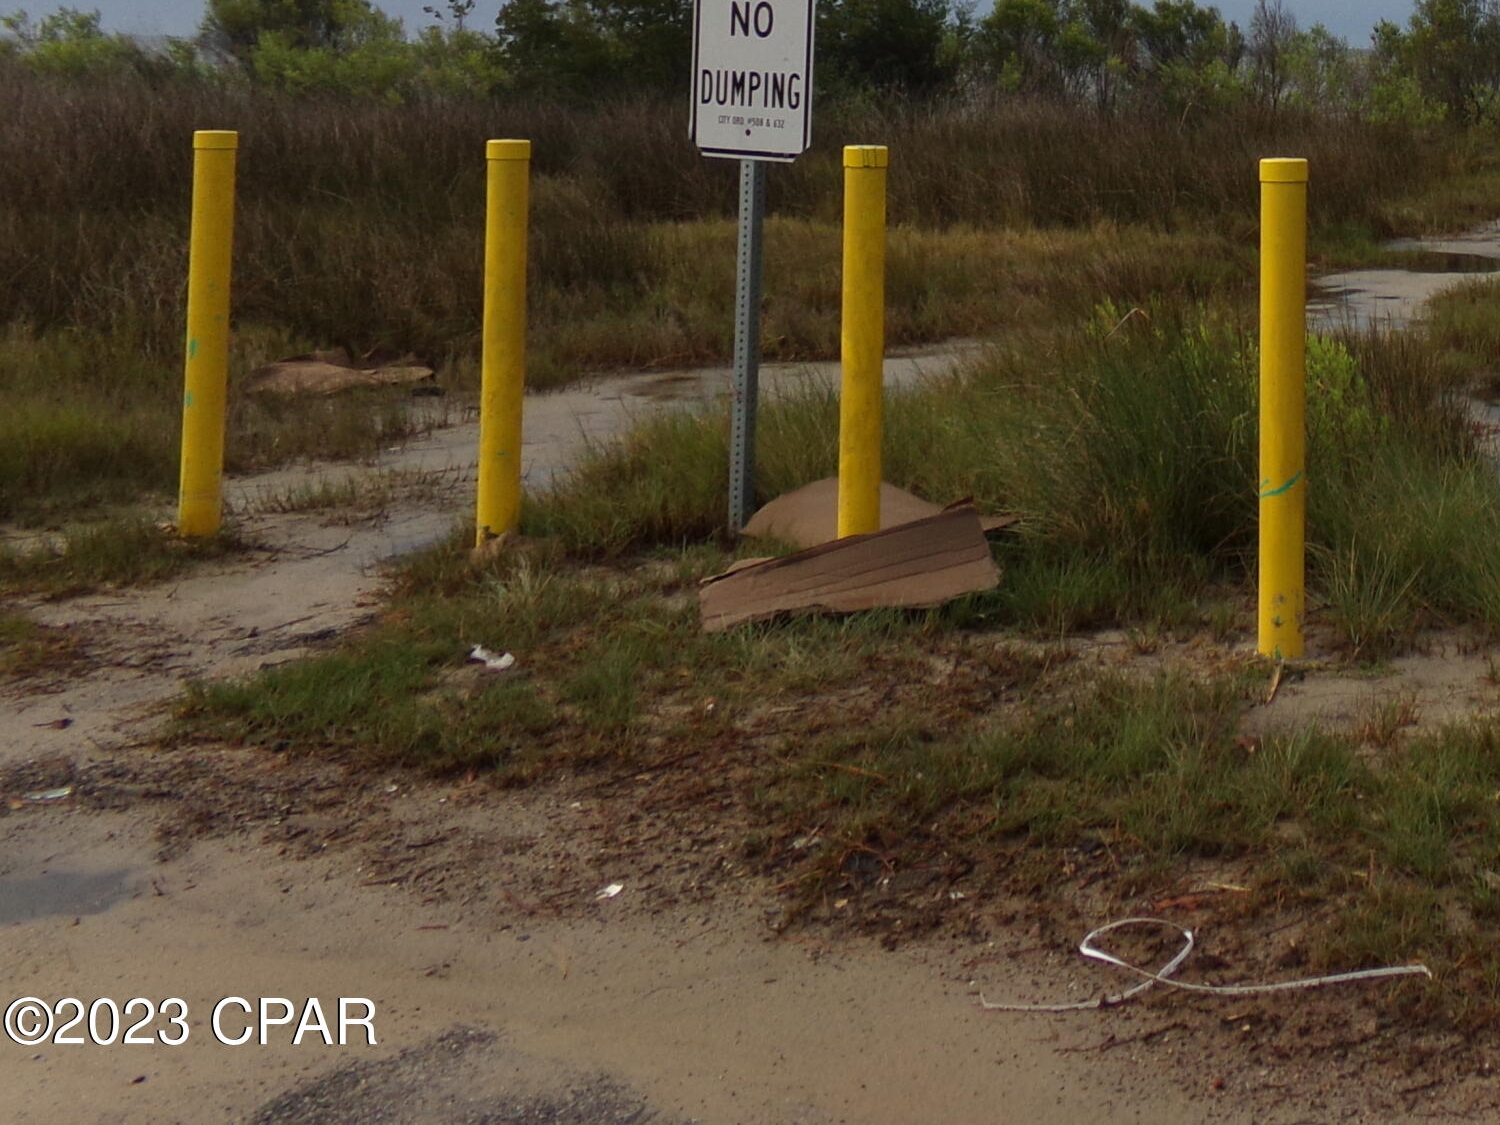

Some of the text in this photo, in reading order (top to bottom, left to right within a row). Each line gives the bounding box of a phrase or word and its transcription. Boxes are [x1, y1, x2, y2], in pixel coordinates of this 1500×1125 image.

[730, 0, 774, 38] NO
[701, 68, 801, 110] DUMPING
[718, 115, 730, 124] CITY
